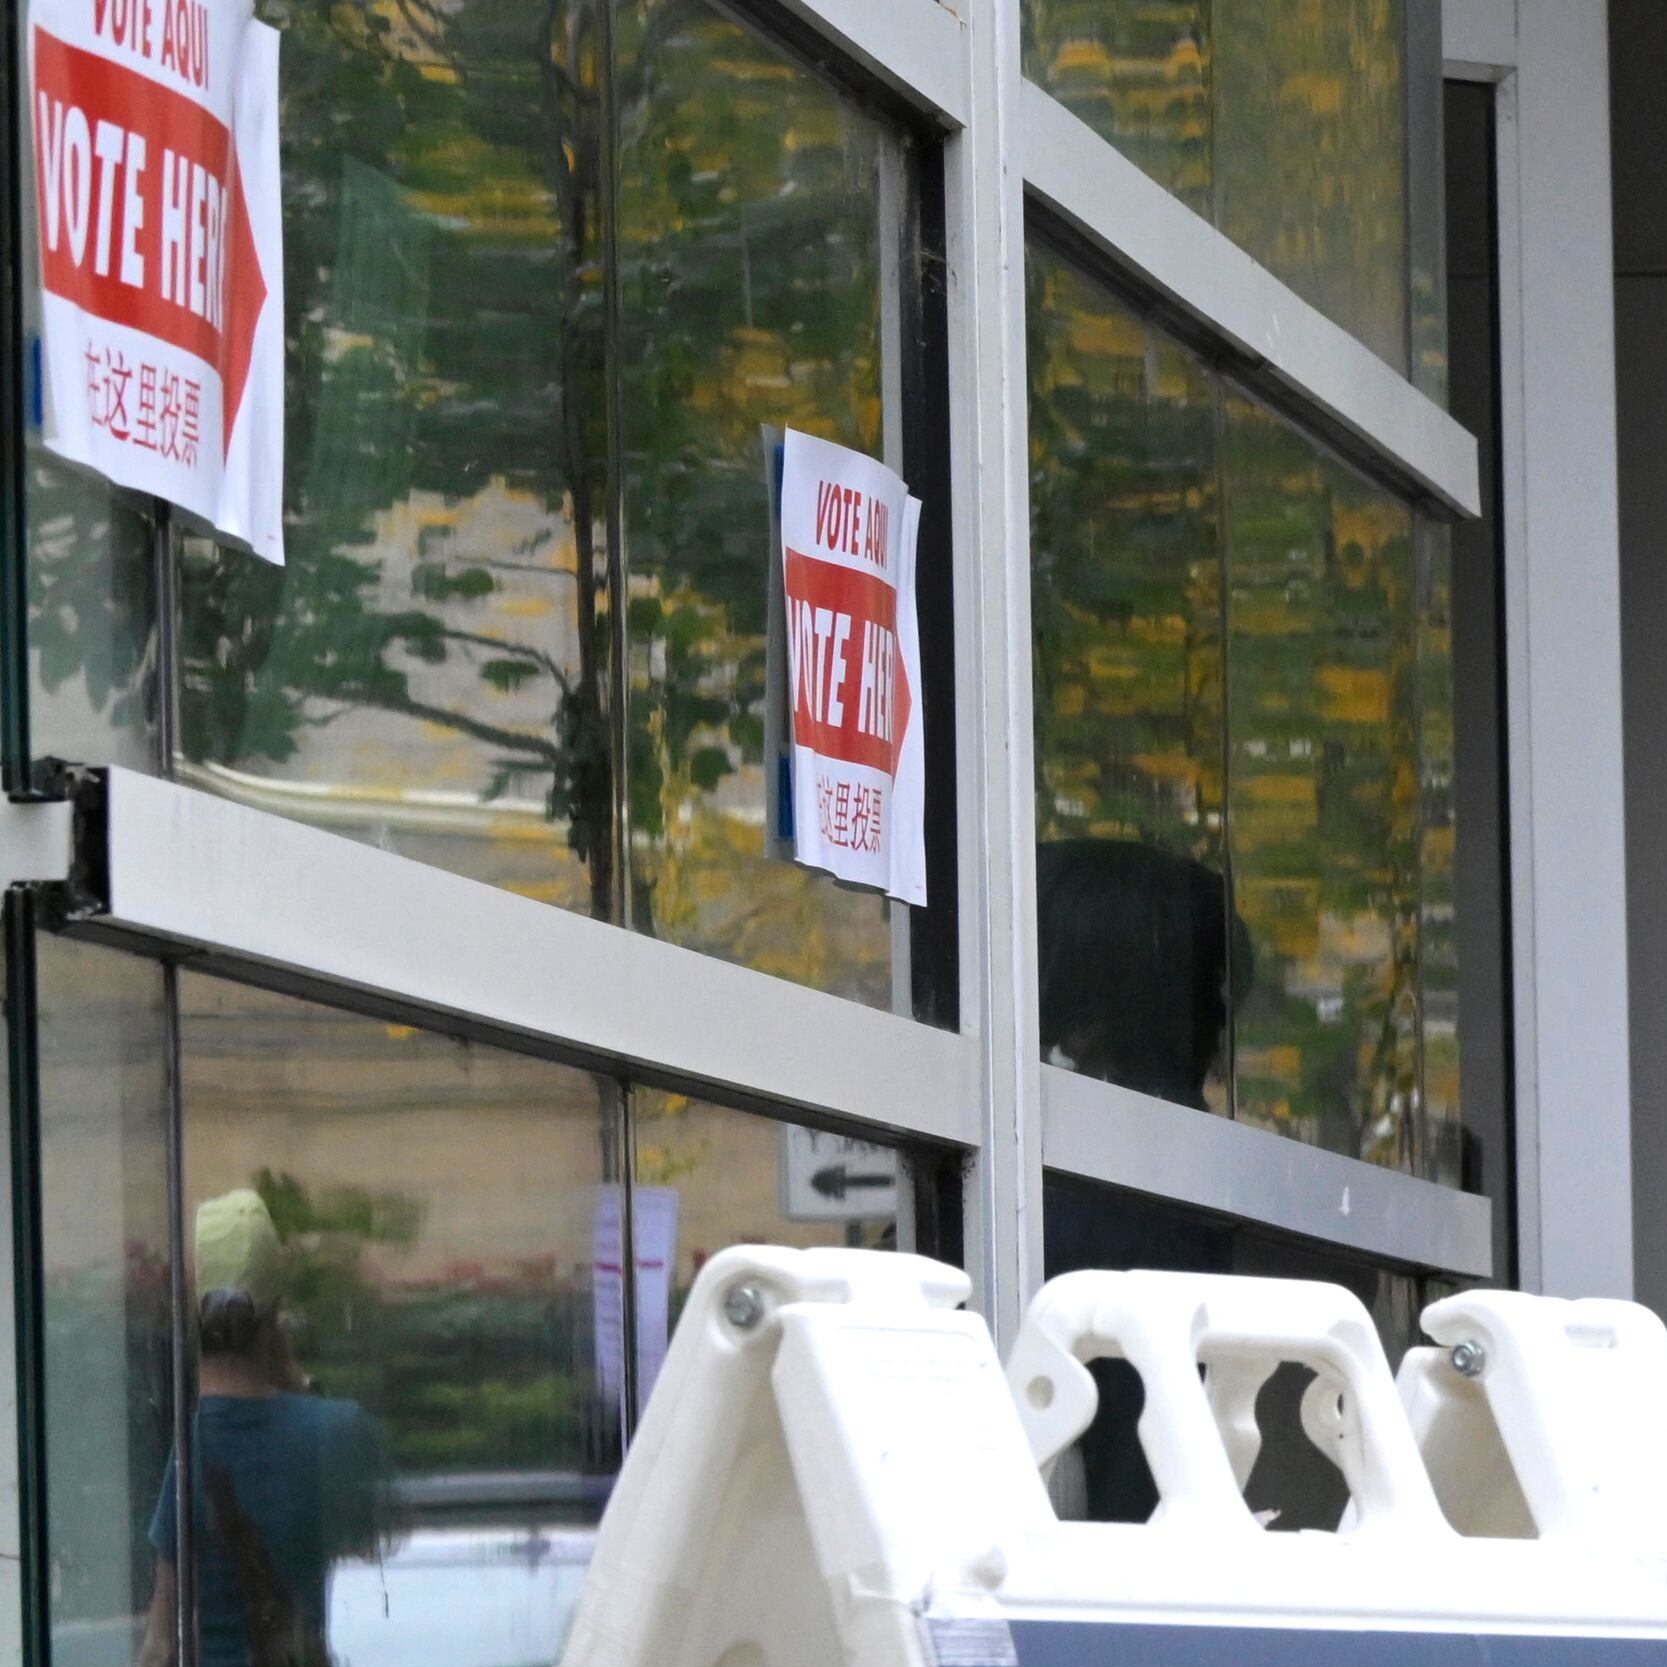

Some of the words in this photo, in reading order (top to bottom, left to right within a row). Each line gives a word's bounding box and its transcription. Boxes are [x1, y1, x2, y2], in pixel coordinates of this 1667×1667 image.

[39, 89, 147, 290] VOTE
[816, 480, 862, 556] VOTE
[787, 594, 852, 729] VOTE
[857, 619, 896, 746] HER
[816, 774, 883, 856] 这里投票
